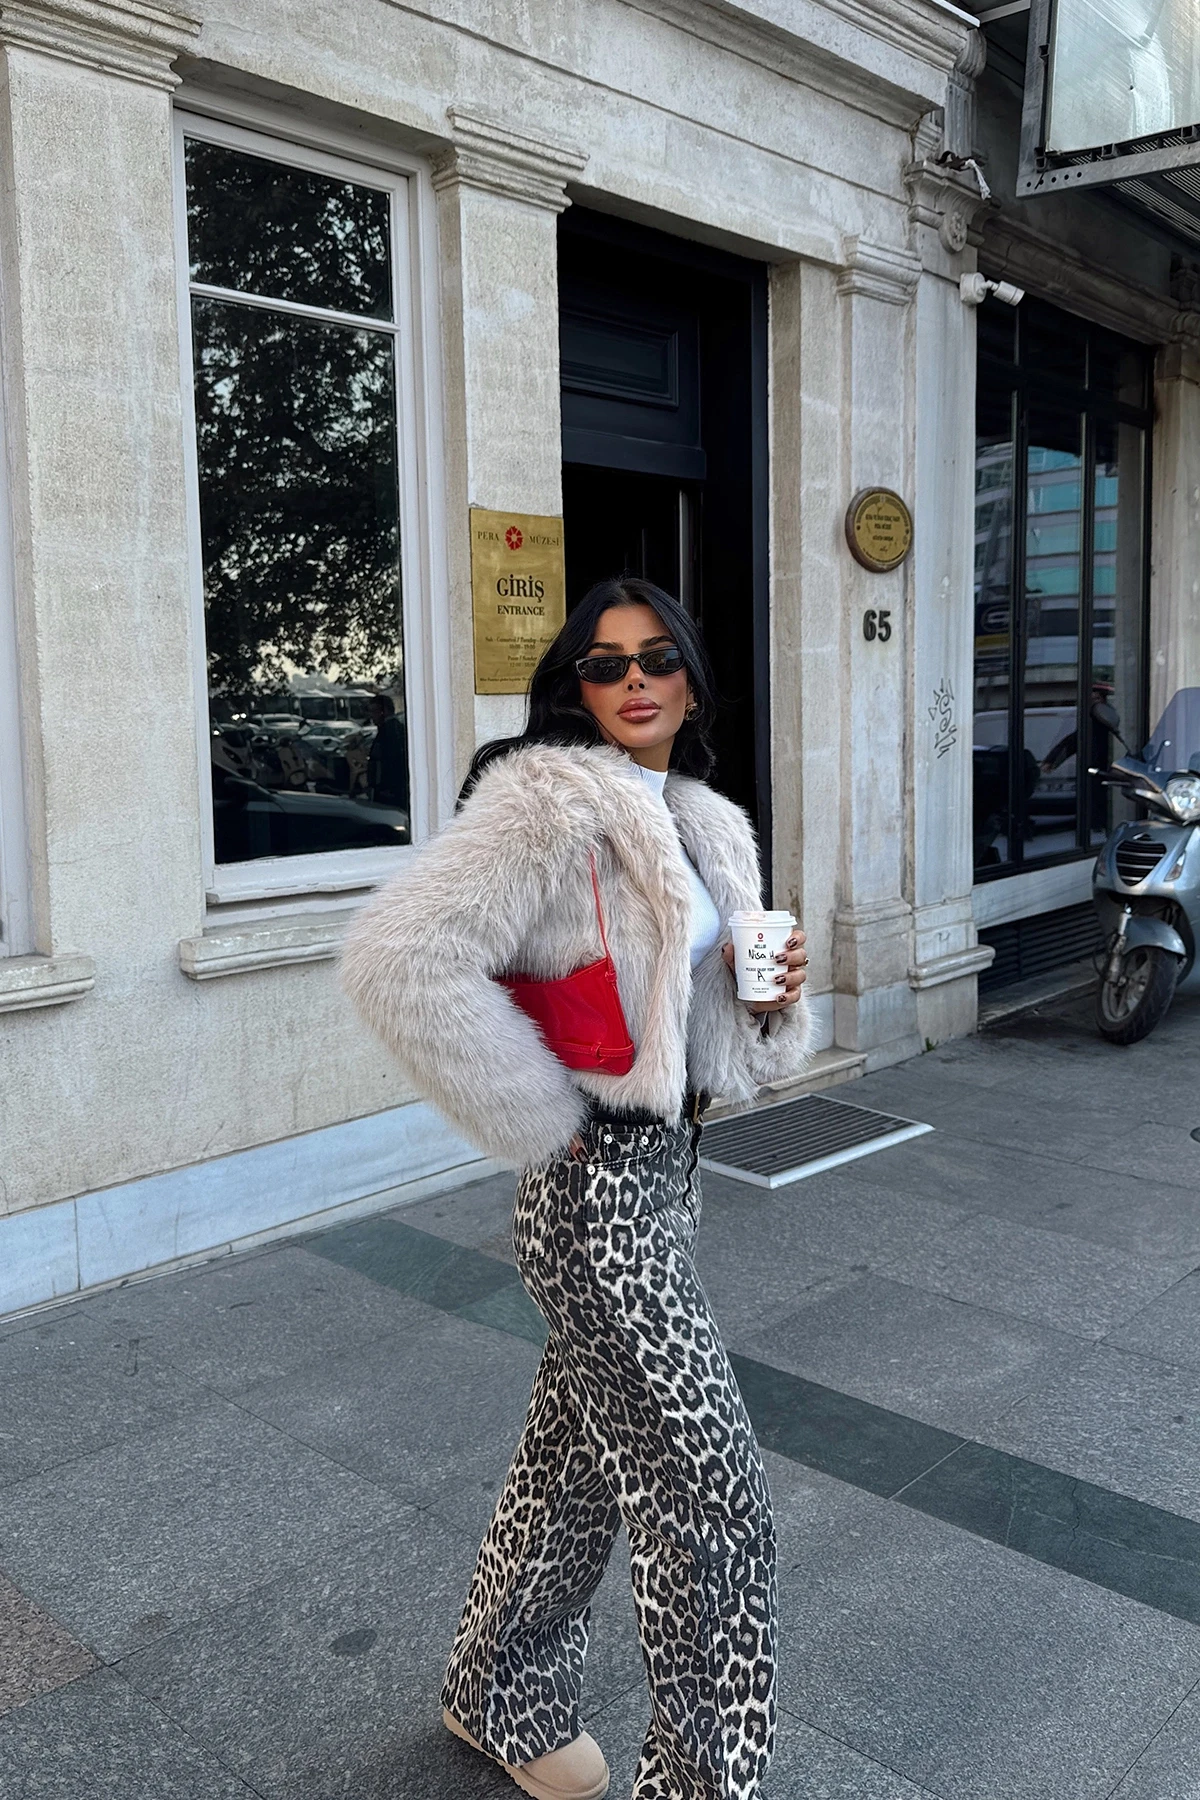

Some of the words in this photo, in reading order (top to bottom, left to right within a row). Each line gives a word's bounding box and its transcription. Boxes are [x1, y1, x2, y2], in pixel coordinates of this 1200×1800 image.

[477, 531, 500, 541] PERA
[529, 535, 560, 546] MÜZESİ
[496, 573, 545, 603] GİRİŞ
[497, 605, 545, 616] ENTRANCE
[863, 609, 892, 642] 65
